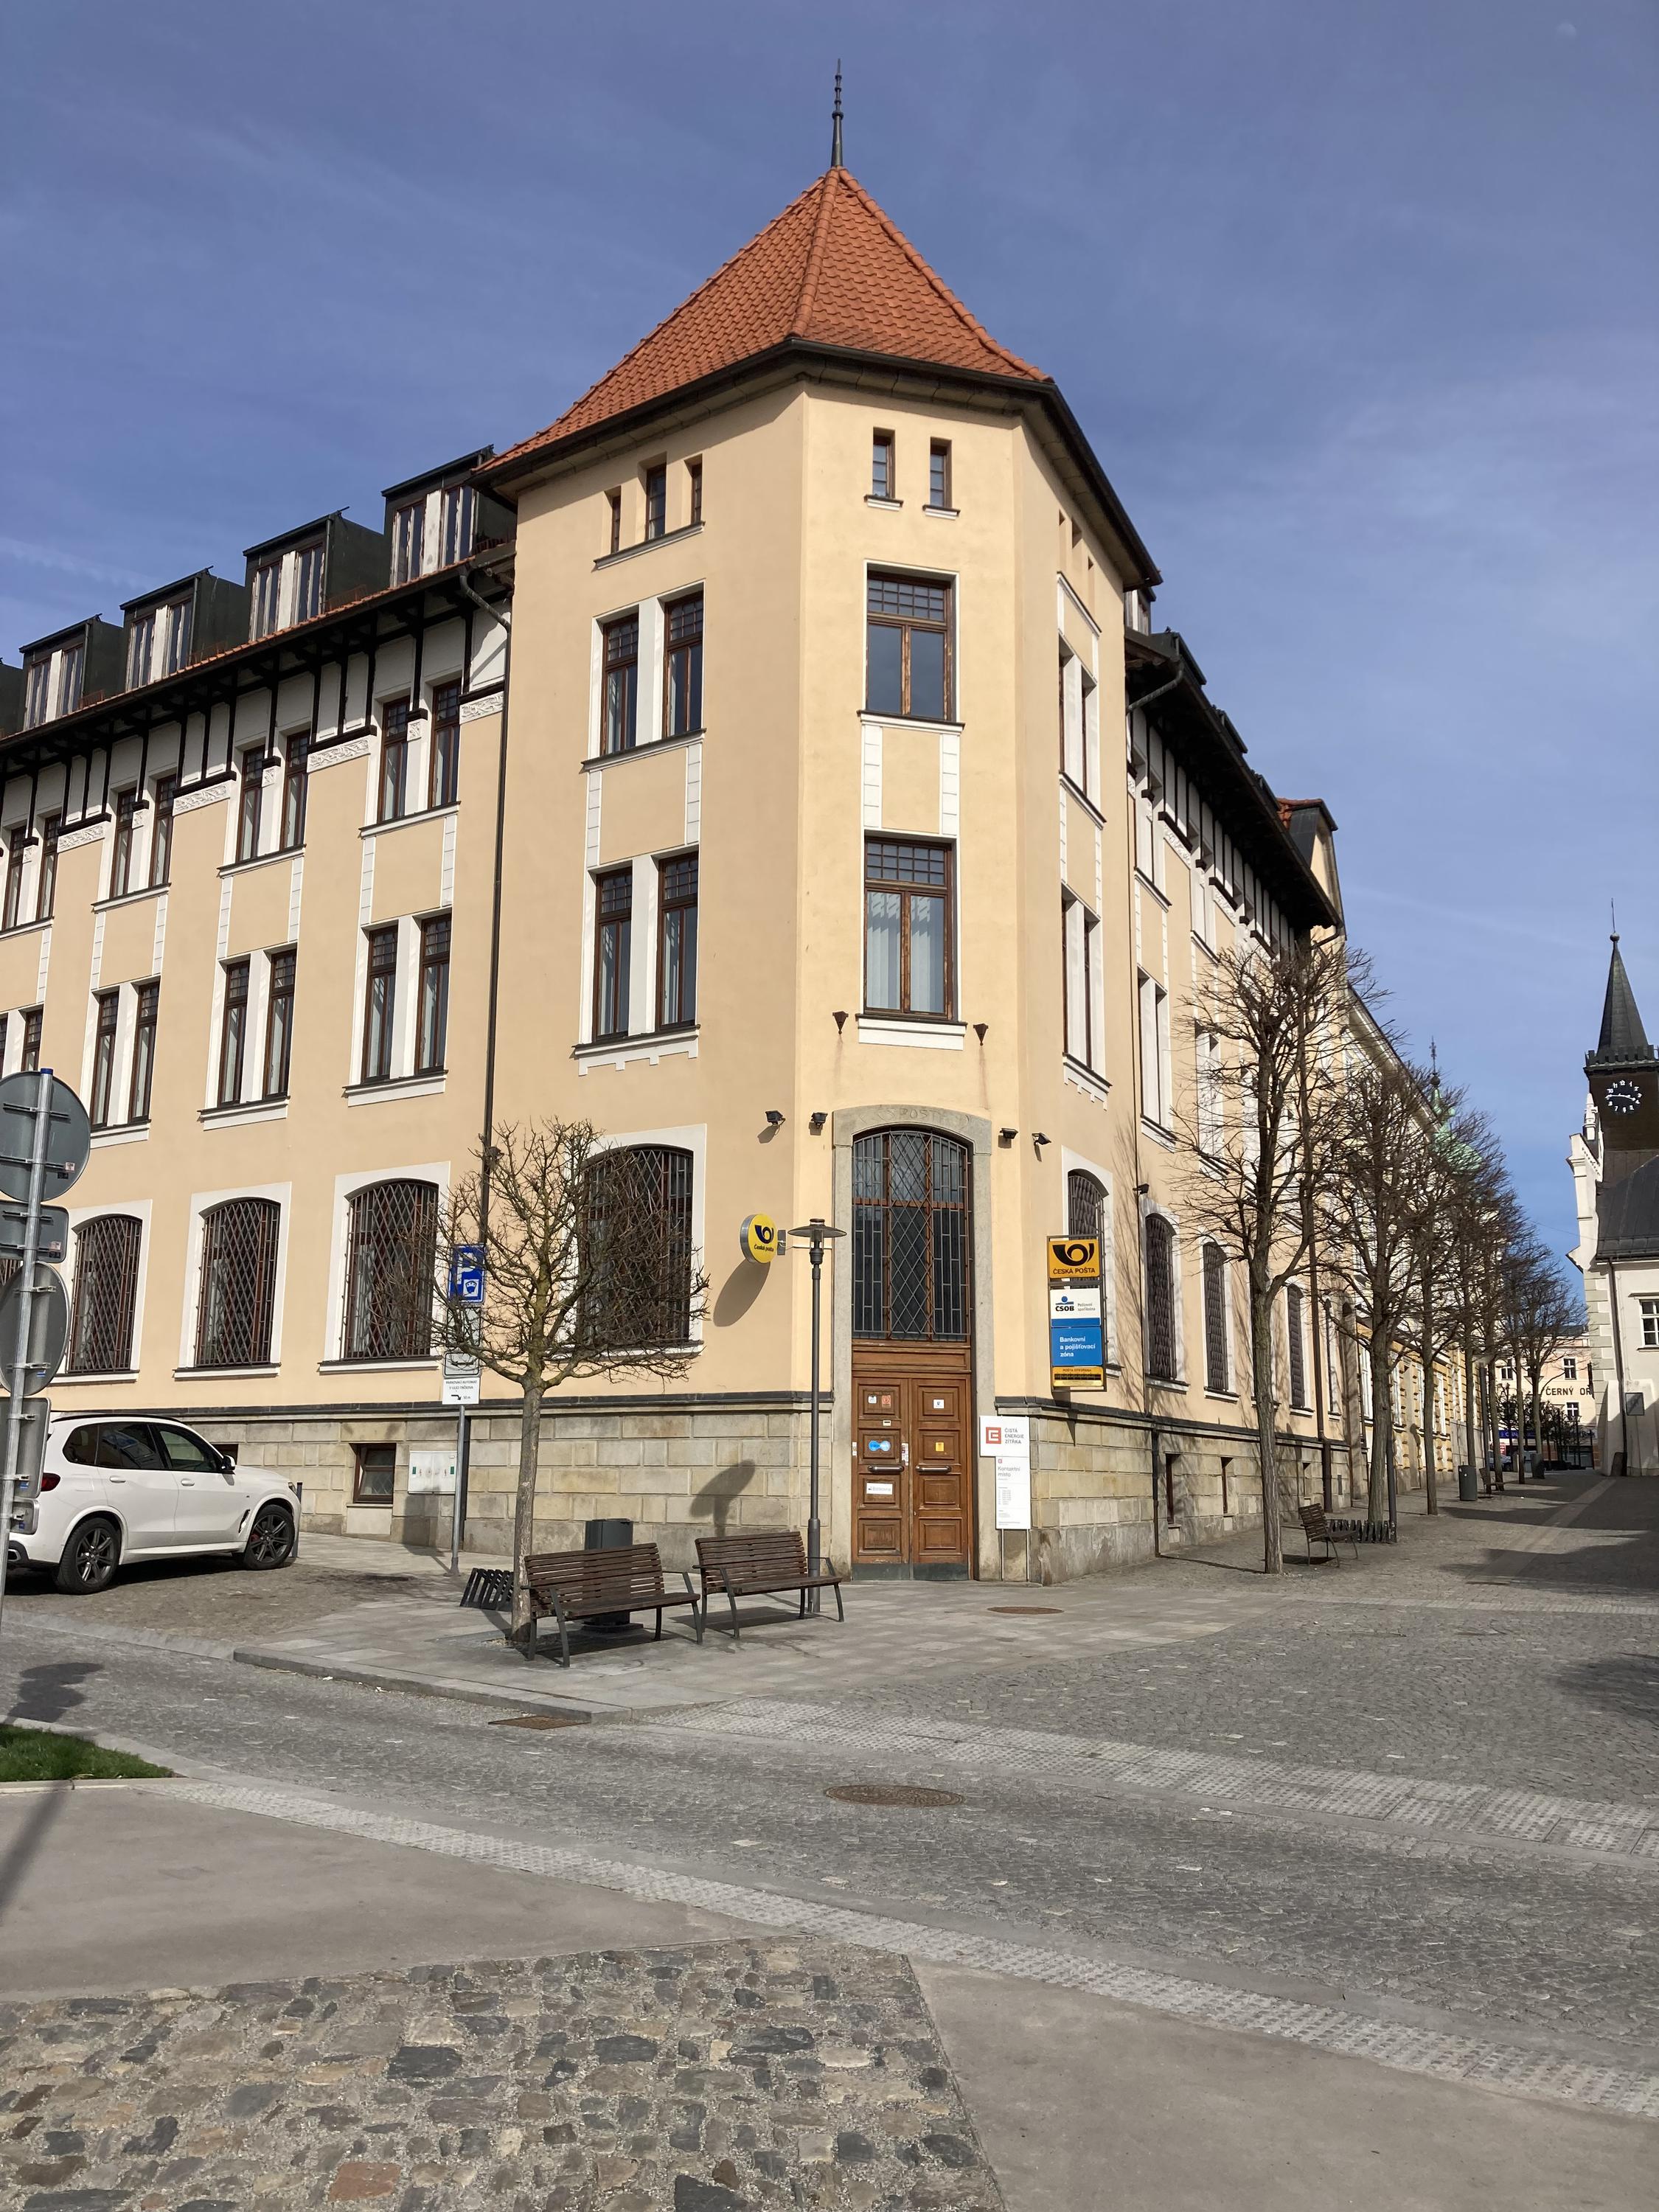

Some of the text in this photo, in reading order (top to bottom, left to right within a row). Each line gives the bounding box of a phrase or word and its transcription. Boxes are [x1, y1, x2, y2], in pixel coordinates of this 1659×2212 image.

[1074, 1266, 1096, 1274] POŠTA
[1065, 1343, 1096, 1351] pojišťovací
[1545, 1386, 1573, 1395] ČERNÝ
